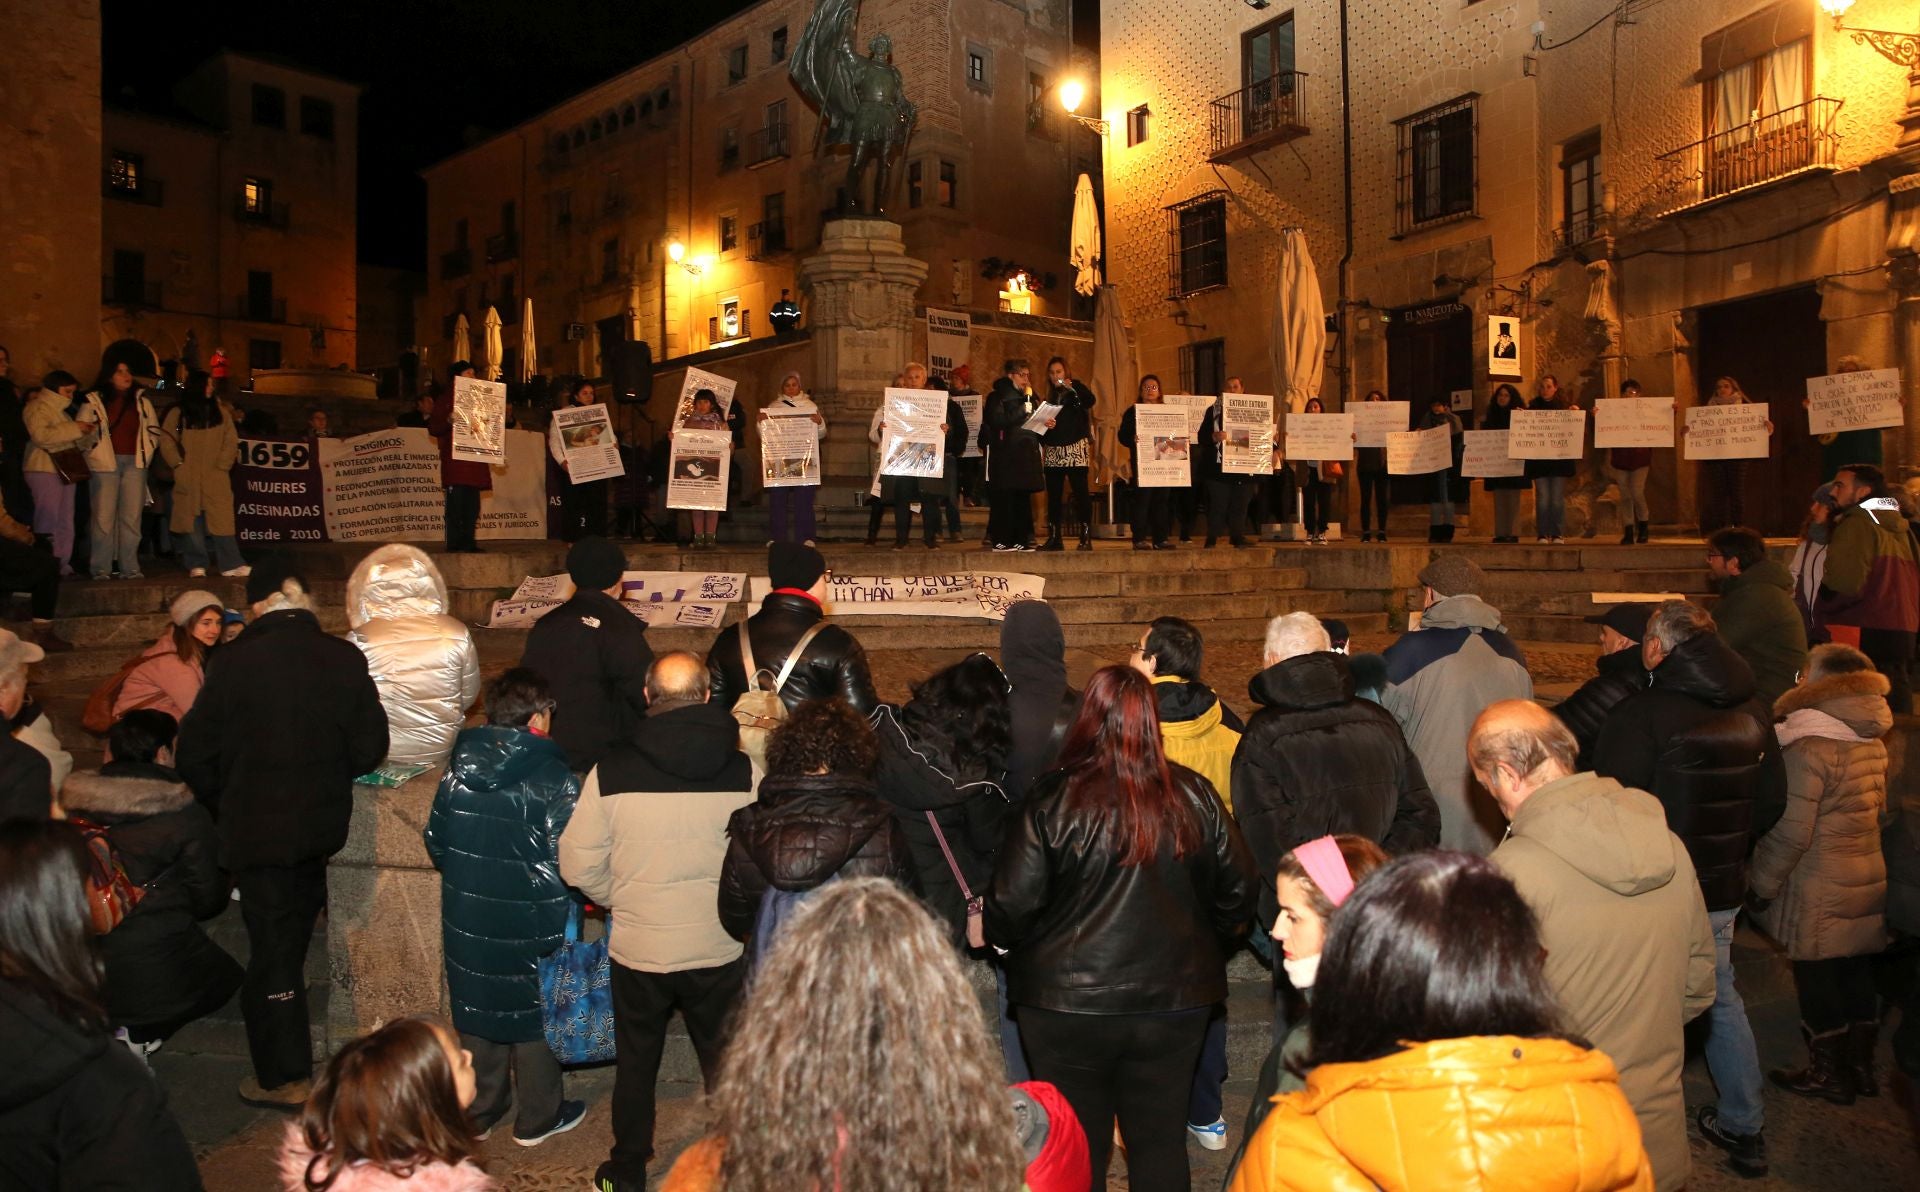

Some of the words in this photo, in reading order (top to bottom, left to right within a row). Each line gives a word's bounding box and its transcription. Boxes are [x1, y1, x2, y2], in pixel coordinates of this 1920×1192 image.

[1416, 303, 1464, 318] NARIZOTAS
[938, 317, 968, 329] SISTEMA
[932, 355, 953, 368] VIOLA
[354, 437, 405, 452] EXIGIMOS:
[237, 441, 308, 467] 1659
[384, 454, 402, 462] REAL
[342, 467, 376, 477] MUJERES
[378, 463, 432, 472] AMENAZADAS
[247, 480, 306, 494] MUJERES
[336, 478, 404, 492] RECONOCIMIENTO
[347, 492, 357, 500] LA
[237, 503, 319, 517] ASESINADAS
[337, 502, 386, 516] EDUCACIÓN
[340, 516, 390, 530] FORMACIÓN
[240, 528, 280, 541] desde
[289, 530, 320, 540] 2010
[342, 531, 357, 539] LOS
[983, 576, 1009, 592] POR
[921, 588, 938, 596] NO
